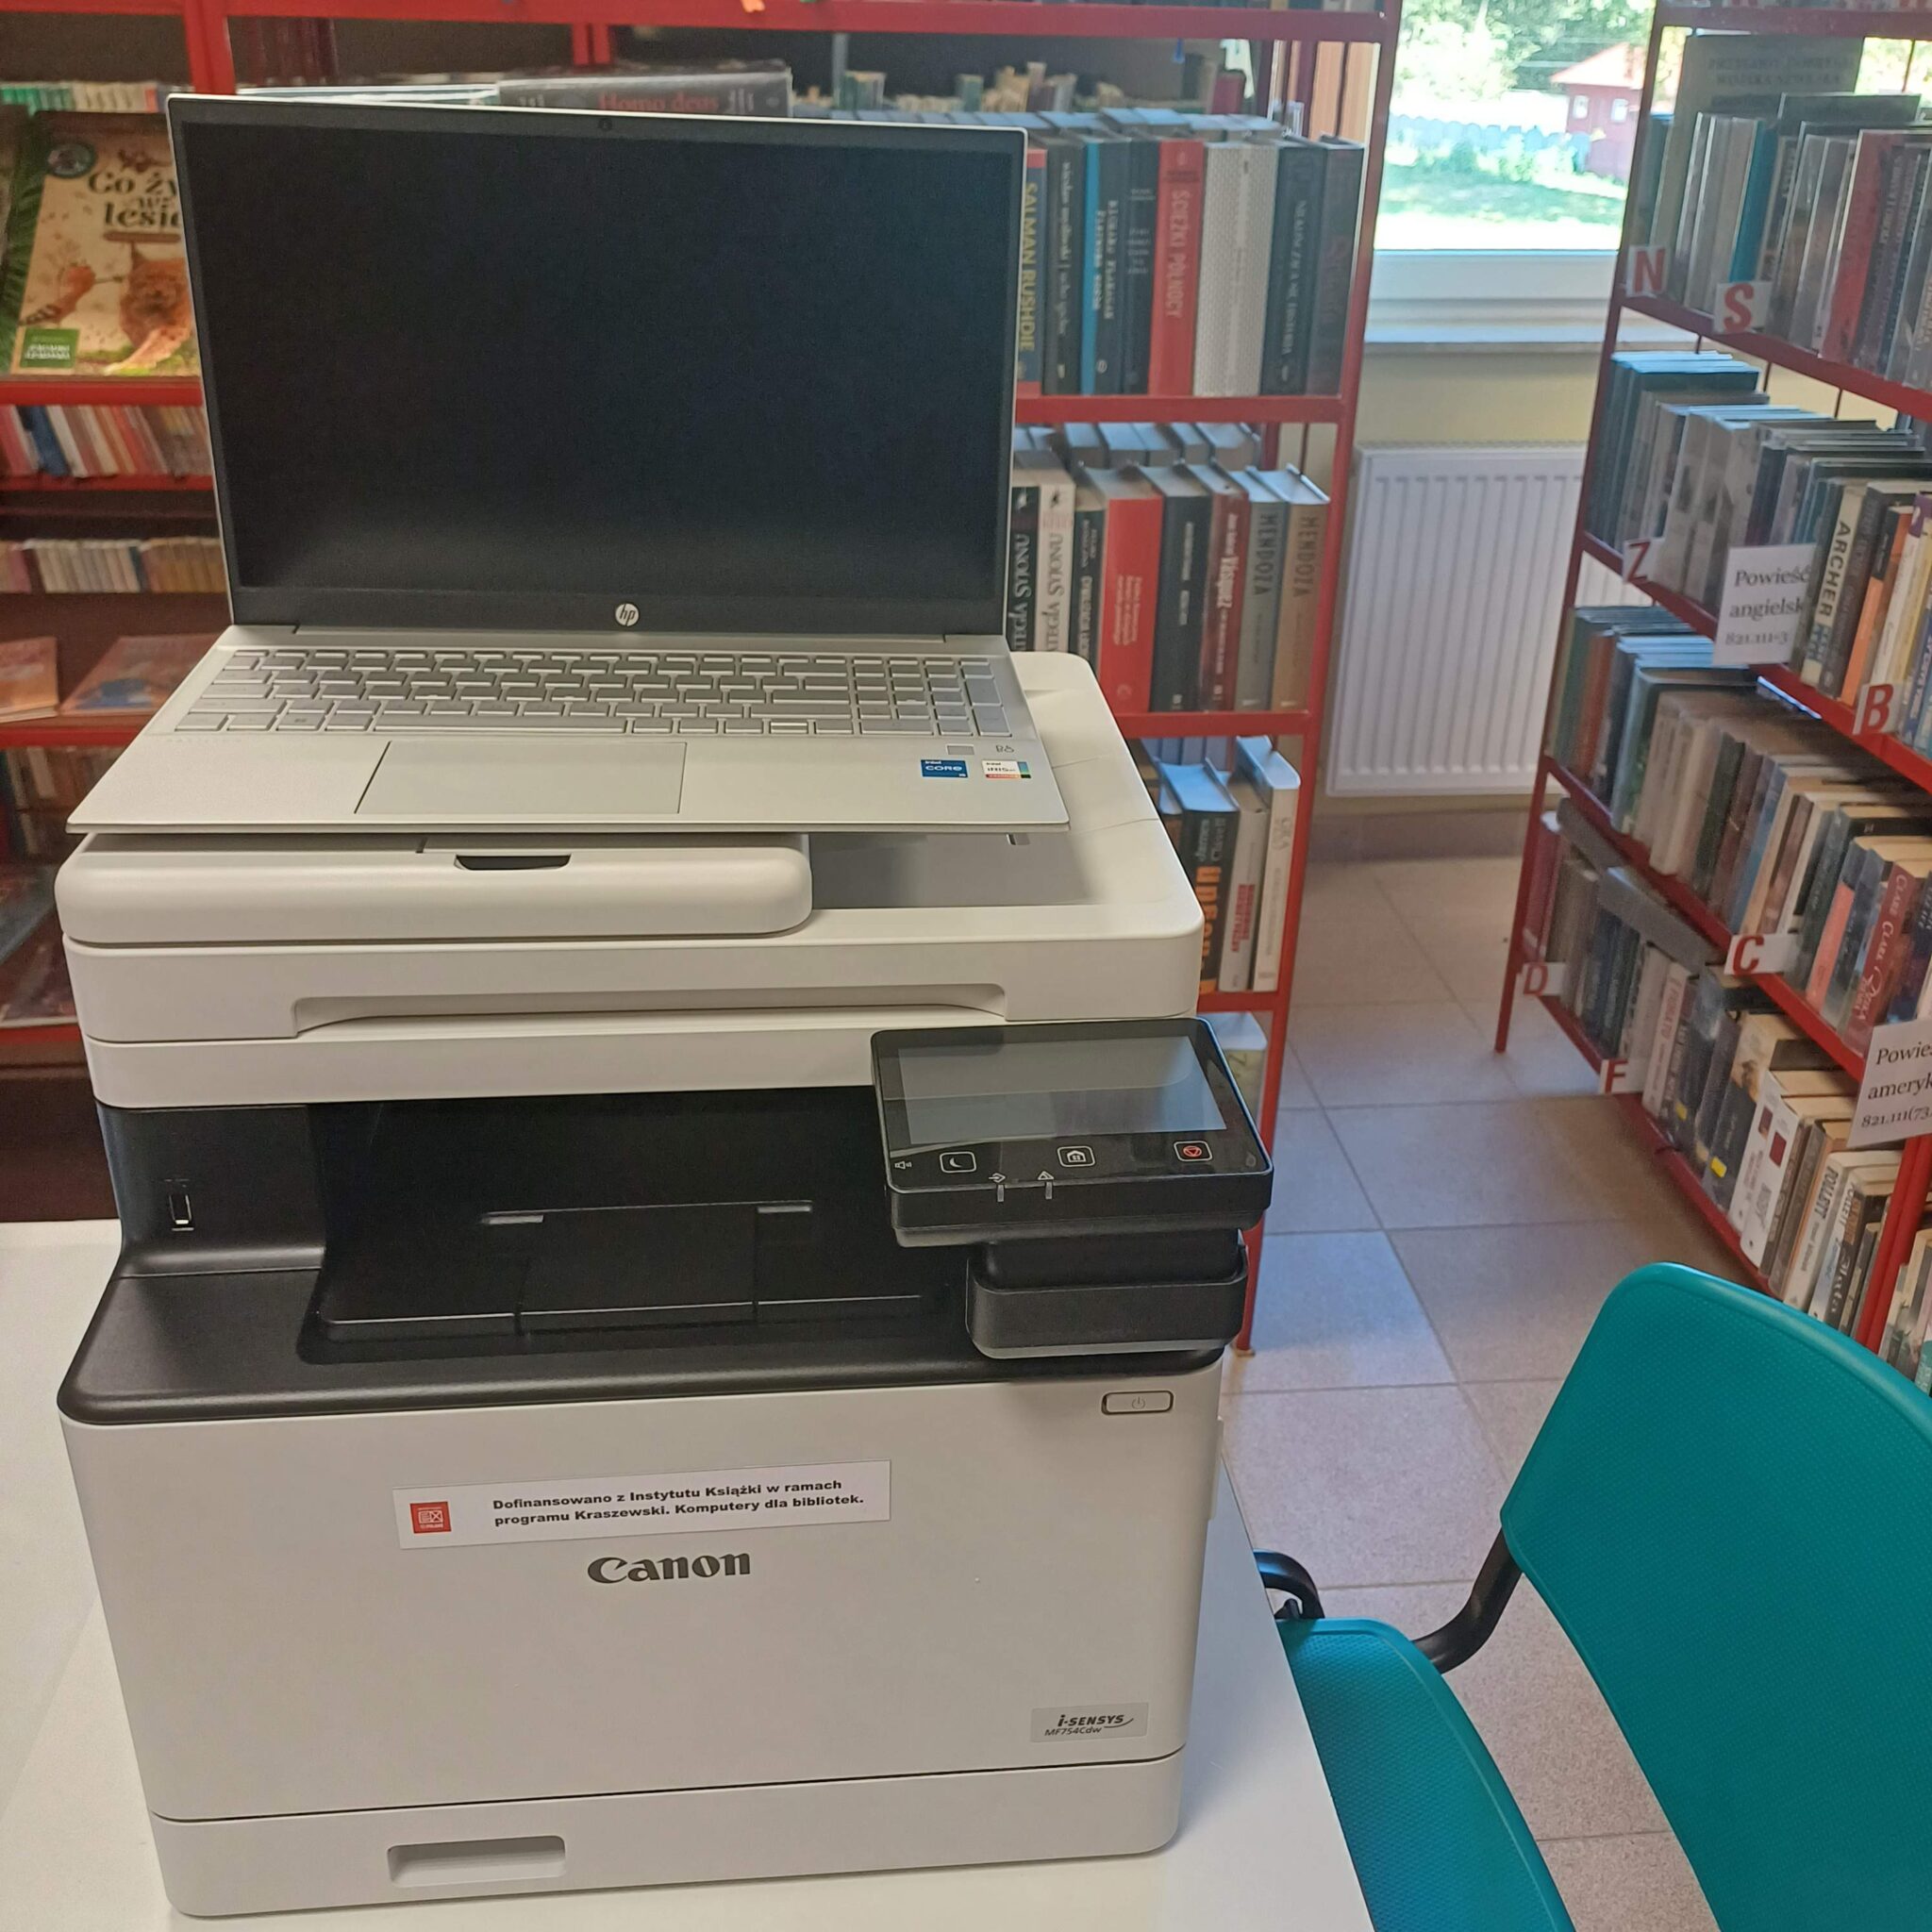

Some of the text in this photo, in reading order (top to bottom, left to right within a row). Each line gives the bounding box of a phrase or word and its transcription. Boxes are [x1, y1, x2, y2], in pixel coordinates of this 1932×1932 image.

[89, 171, 136, 195] Co
[1018, 182, 1039, 351] SALMAN RUSHDIE
[1633, 248, 1665, 294] N
[1724, 284, 1754, 332] S
[1253, 513, 1278, 596] MENDOZA
[1291, 516, 1320, 598] MENDOZA
[1627, 541, 1651, 583] Z
[1817, 520, 1853, 617] ARCHER
[1735, 564, 1810, 587] Powieść
[619, 604, 637, 625] hp
[1863, 684, 1894, 734] B
[1732, 935, 1765, 974] C
[1523, 963, 1548, 995] D
[1605, 1058, 1628, 1092] F
[1861, 1106, 1932, 1127] 821.111(73
[1813, 1166, 1839, 1219] FOLLETT
[493, 1494, 612, 1509] Dofinansowano
[630, 1489, 700, 1502] Instytutu
[706, 1485, 761, 1497] Książki
[785, 1480, 841, 1492] ramach
[495, 1494, 864, 1527] programu Kraszewski. Komputery dla bibliotek.
[588, 1553, 751, 1584] Canon
[1044, 1726, 1103, 1737] MF754Cdw
[1058, 1714, 1126, 1727] i-SENSYS
